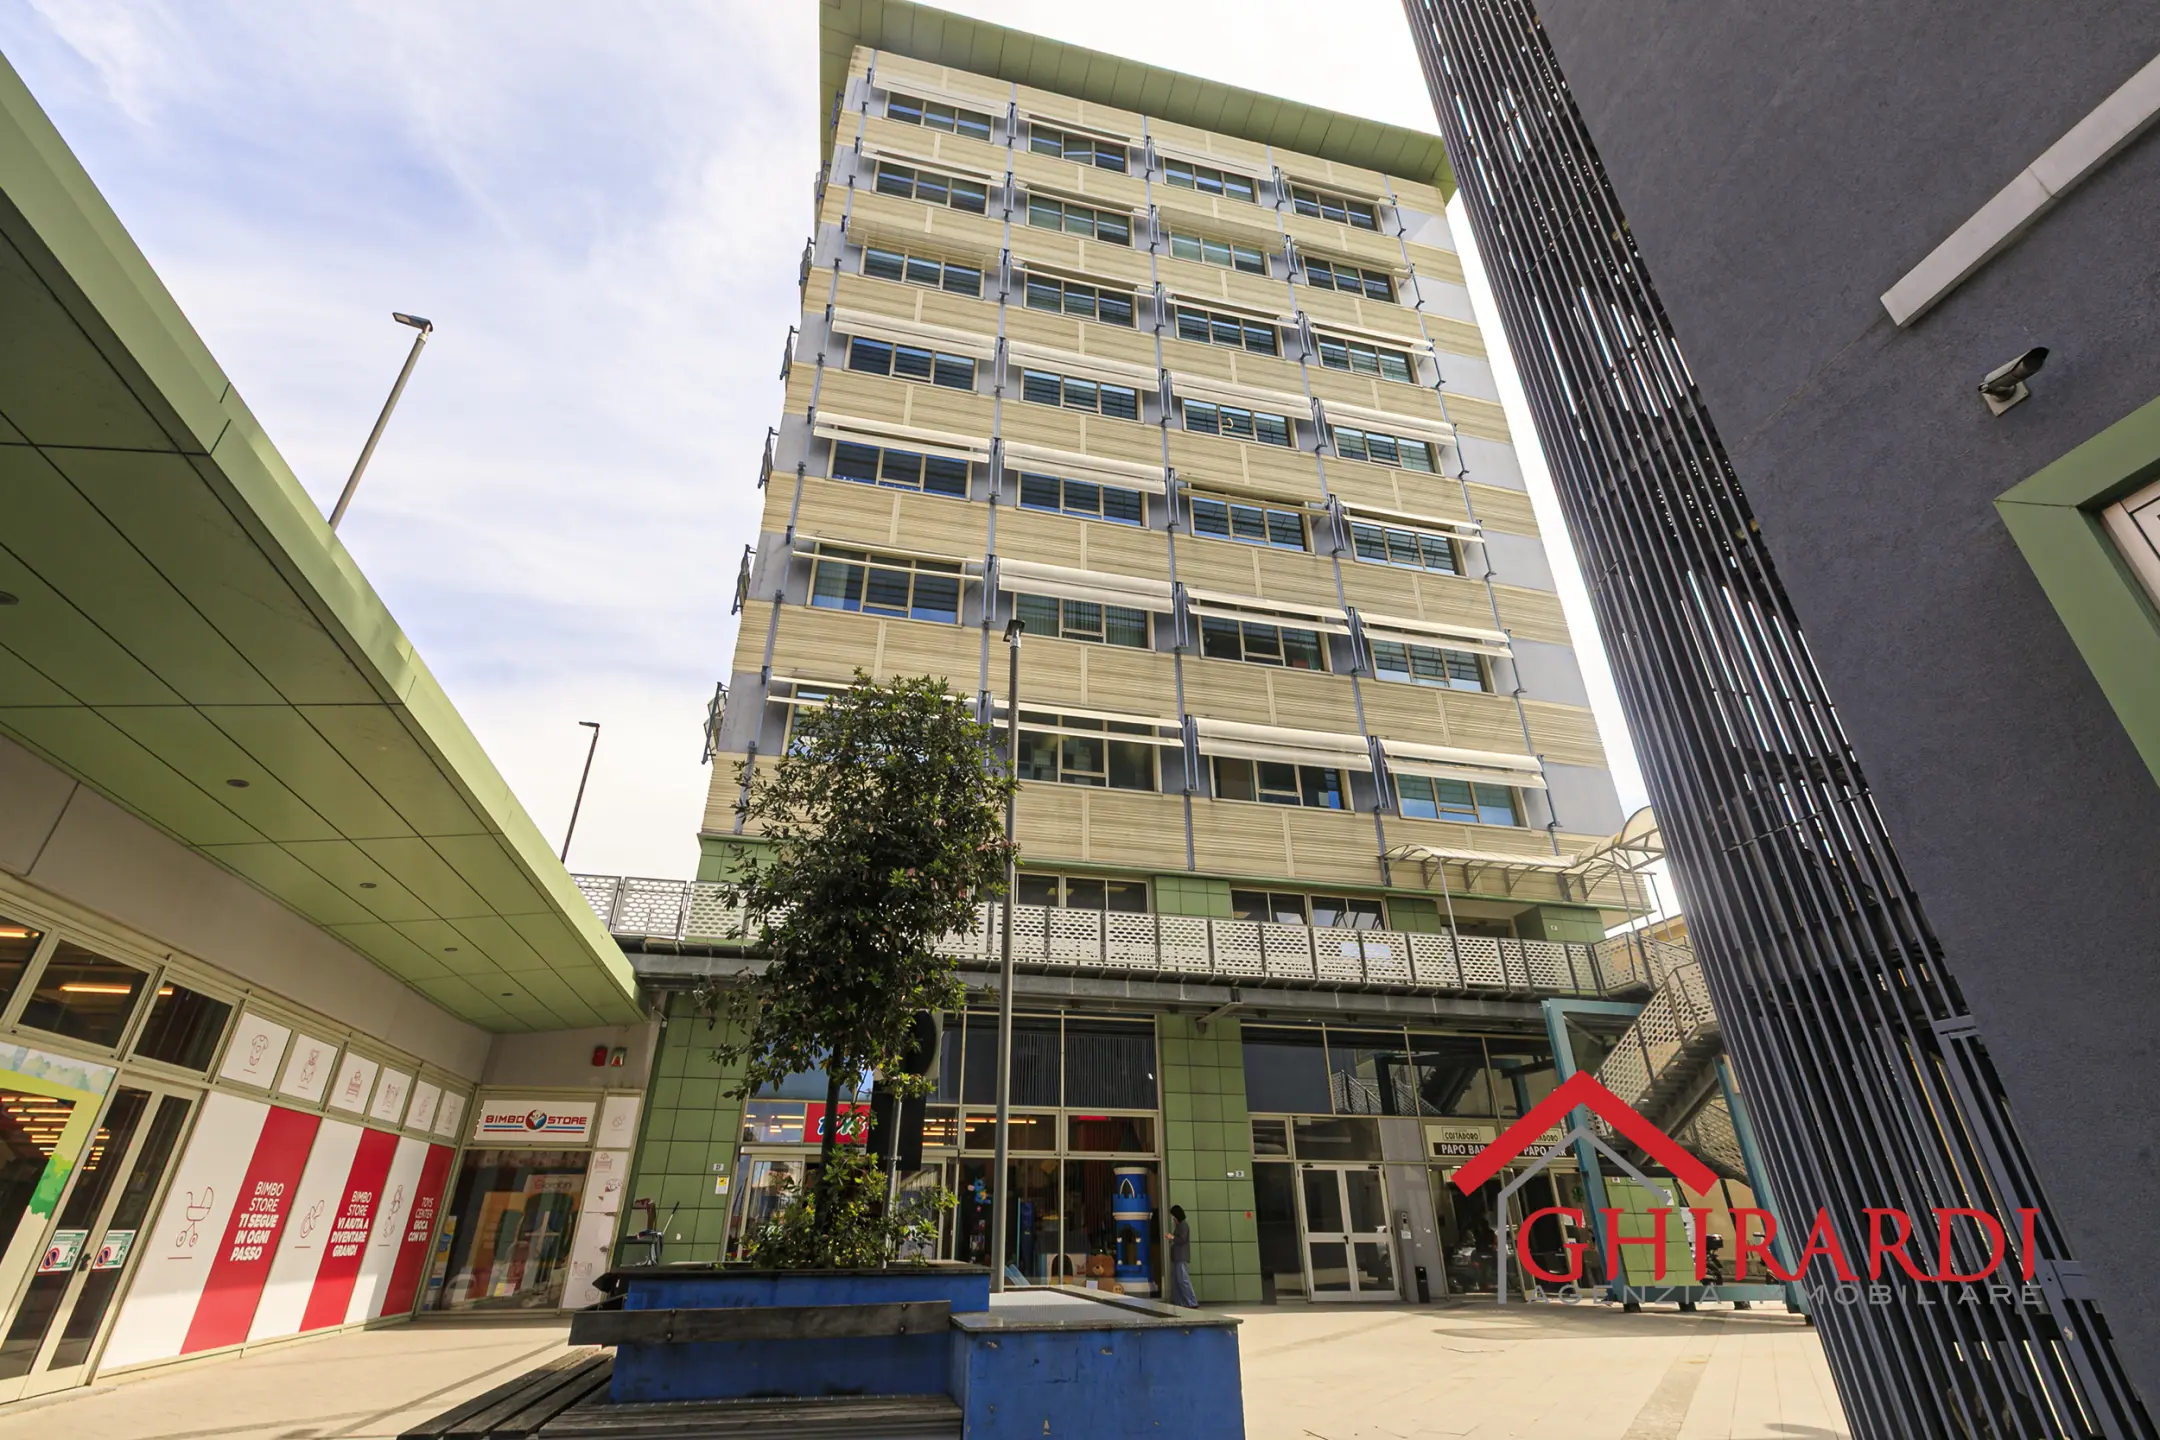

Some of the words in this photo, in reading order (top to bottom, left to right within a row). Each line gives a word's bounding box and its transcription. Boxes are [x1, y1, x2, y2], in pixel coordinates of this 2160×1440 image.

[485, 1115, 525, 1123] BIMBO
[547, 1116, 588, 1125] STORE
[1441, 1144, 1466, 1155] PAPO
[1523, 1145, 1547, 1156] PAPO
[255, 1181, 284, 1196] BIMBO
[351, 1191, 372, 1203] BIMBO
[249, 1197, 279, 1212] STORE
[347, 1204, 368, 1216] STORE
[415, 1207, 433, 1219] CENTER
[238, 1213, 249, 1228] TI
[248, 1214, 279, 1228] SEGUE
[337, 1217, 345, 1229] VI
[363, 1218, 369, 1229] A
[234, 1230, 248, 1244] IN
[246, 1230, 271, 1244] OGNI
[330, 1231, 367, 1243] DIVENTARE
[230, 1246, 262, 1261] PASSO
[333, 1244, 358, 1257] GRANDI
